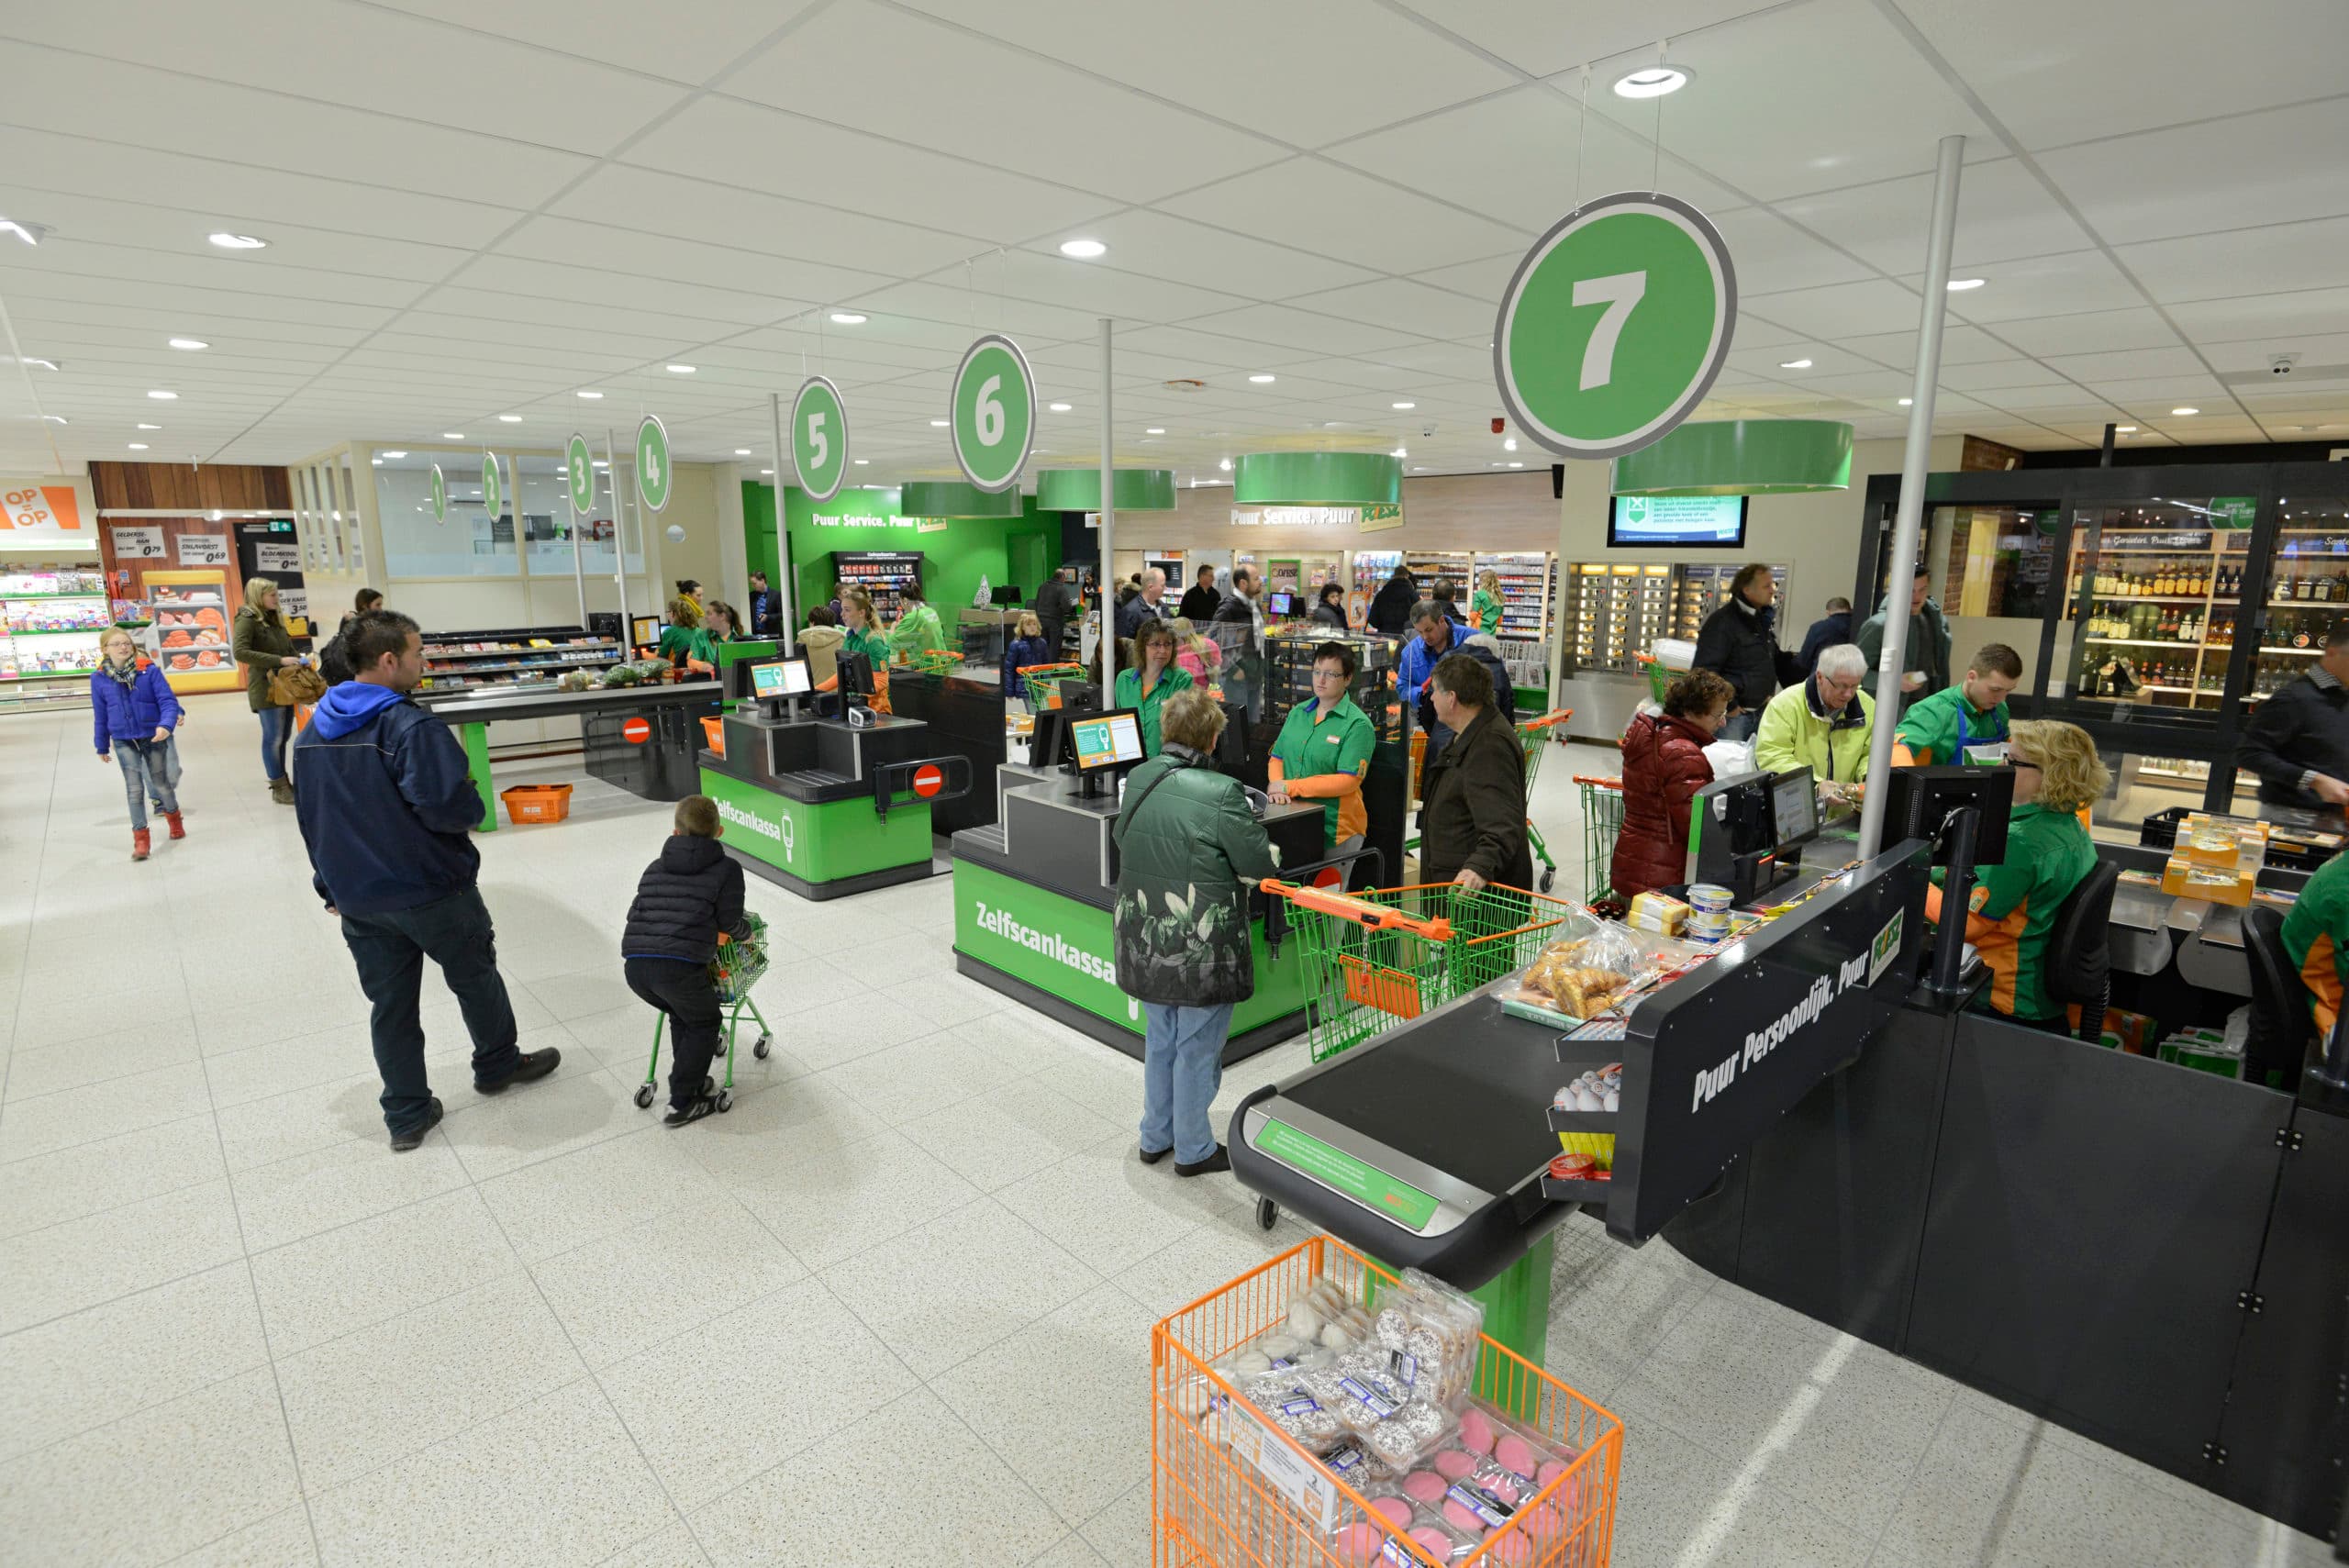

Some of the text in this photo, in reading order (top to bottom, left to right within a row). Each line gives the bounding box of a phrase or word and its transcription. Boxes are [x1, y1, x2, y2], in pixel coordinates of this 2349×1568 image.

[1572, 270, 1646, 392] 7
[975, 374, 1005, 446] 6
[808, 412, 828, 470] 5
[574, 456, 585, 495] 3
[646, 444, 660, 487] 4
[6, 489, 38, 506] OP
[487, 474, 495, 500] 2
[17, 510, 49, 526] OP
[812, 514, 840, 527] Puur
[842, 513, 886, 528] Service.
[889, 515, 914, 528] Puur
[1230, 509, 1260, 525] Puur
[1320, 507, 1354, 525] Puur
[976, 901, 1117, 985] Zelfscankassa
[1692, 1051, 1740, 1114] Puur
[1742, 974, 1834, 1073] Persoonlijk.
[1838, 950, 1869, 995] Puur
